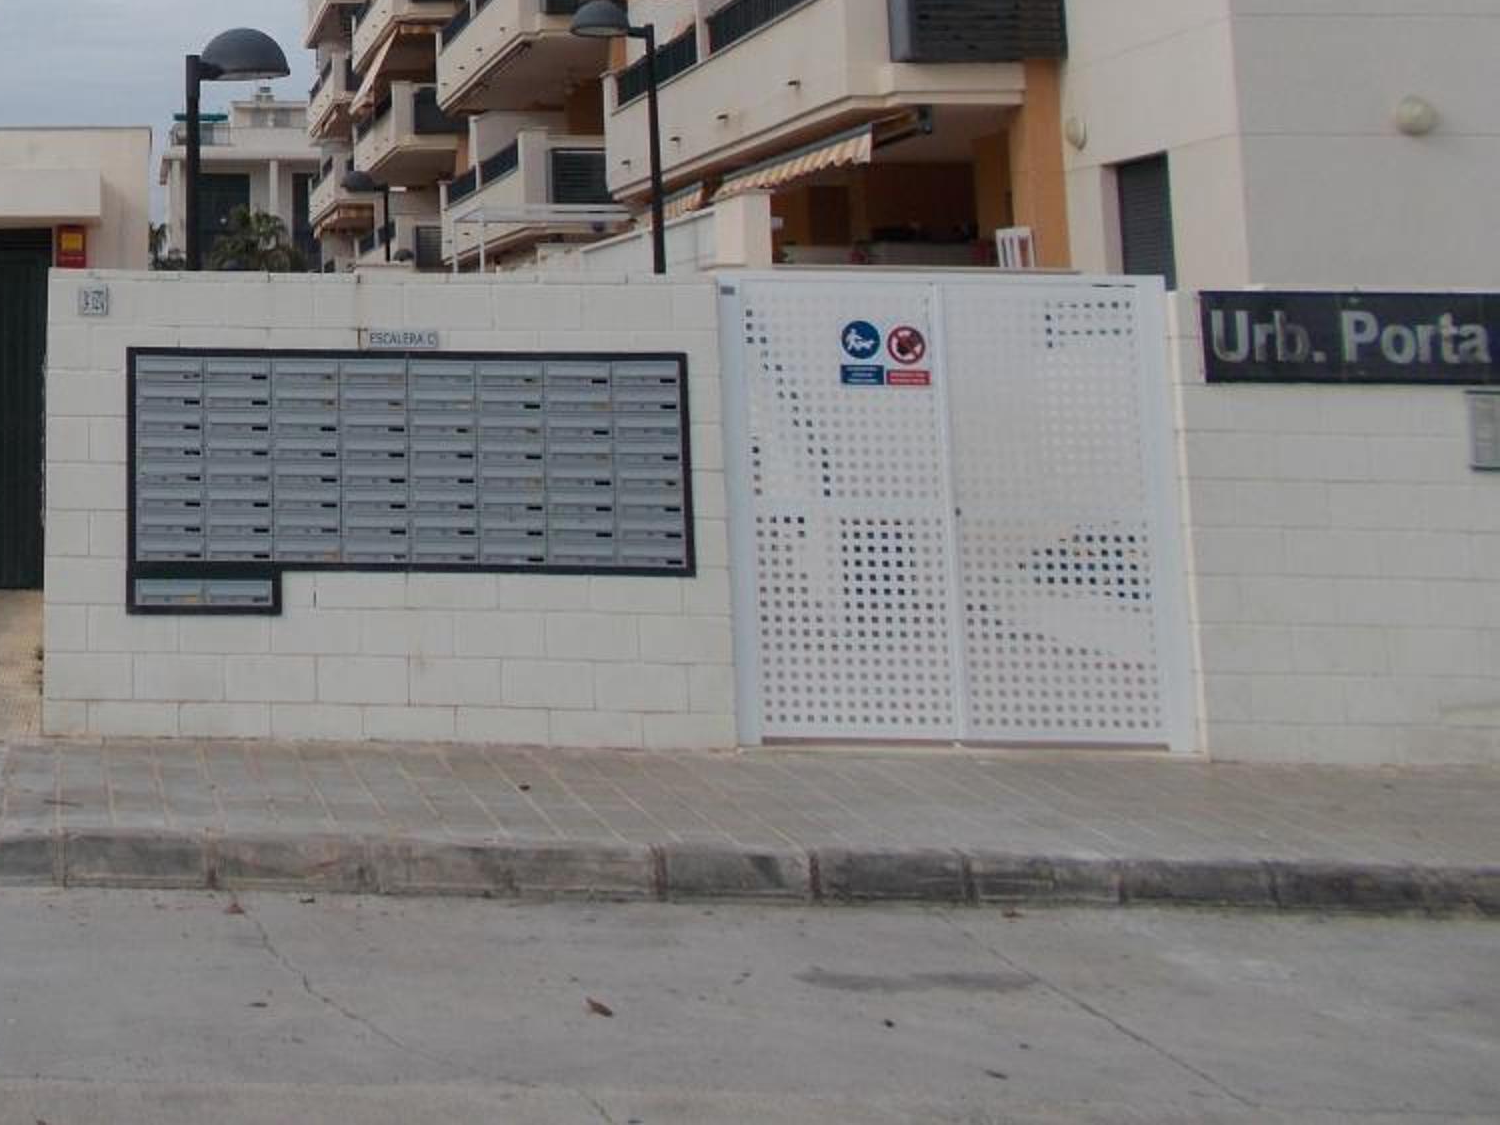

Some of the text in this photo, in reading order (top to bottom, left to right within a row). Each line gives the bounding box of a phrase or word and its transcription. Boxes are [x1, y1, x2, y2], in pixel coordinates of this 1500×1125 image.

[370, 332, 423, 344] ESCALERA
[1210, 309, 1492, 364] Urb. Porta
